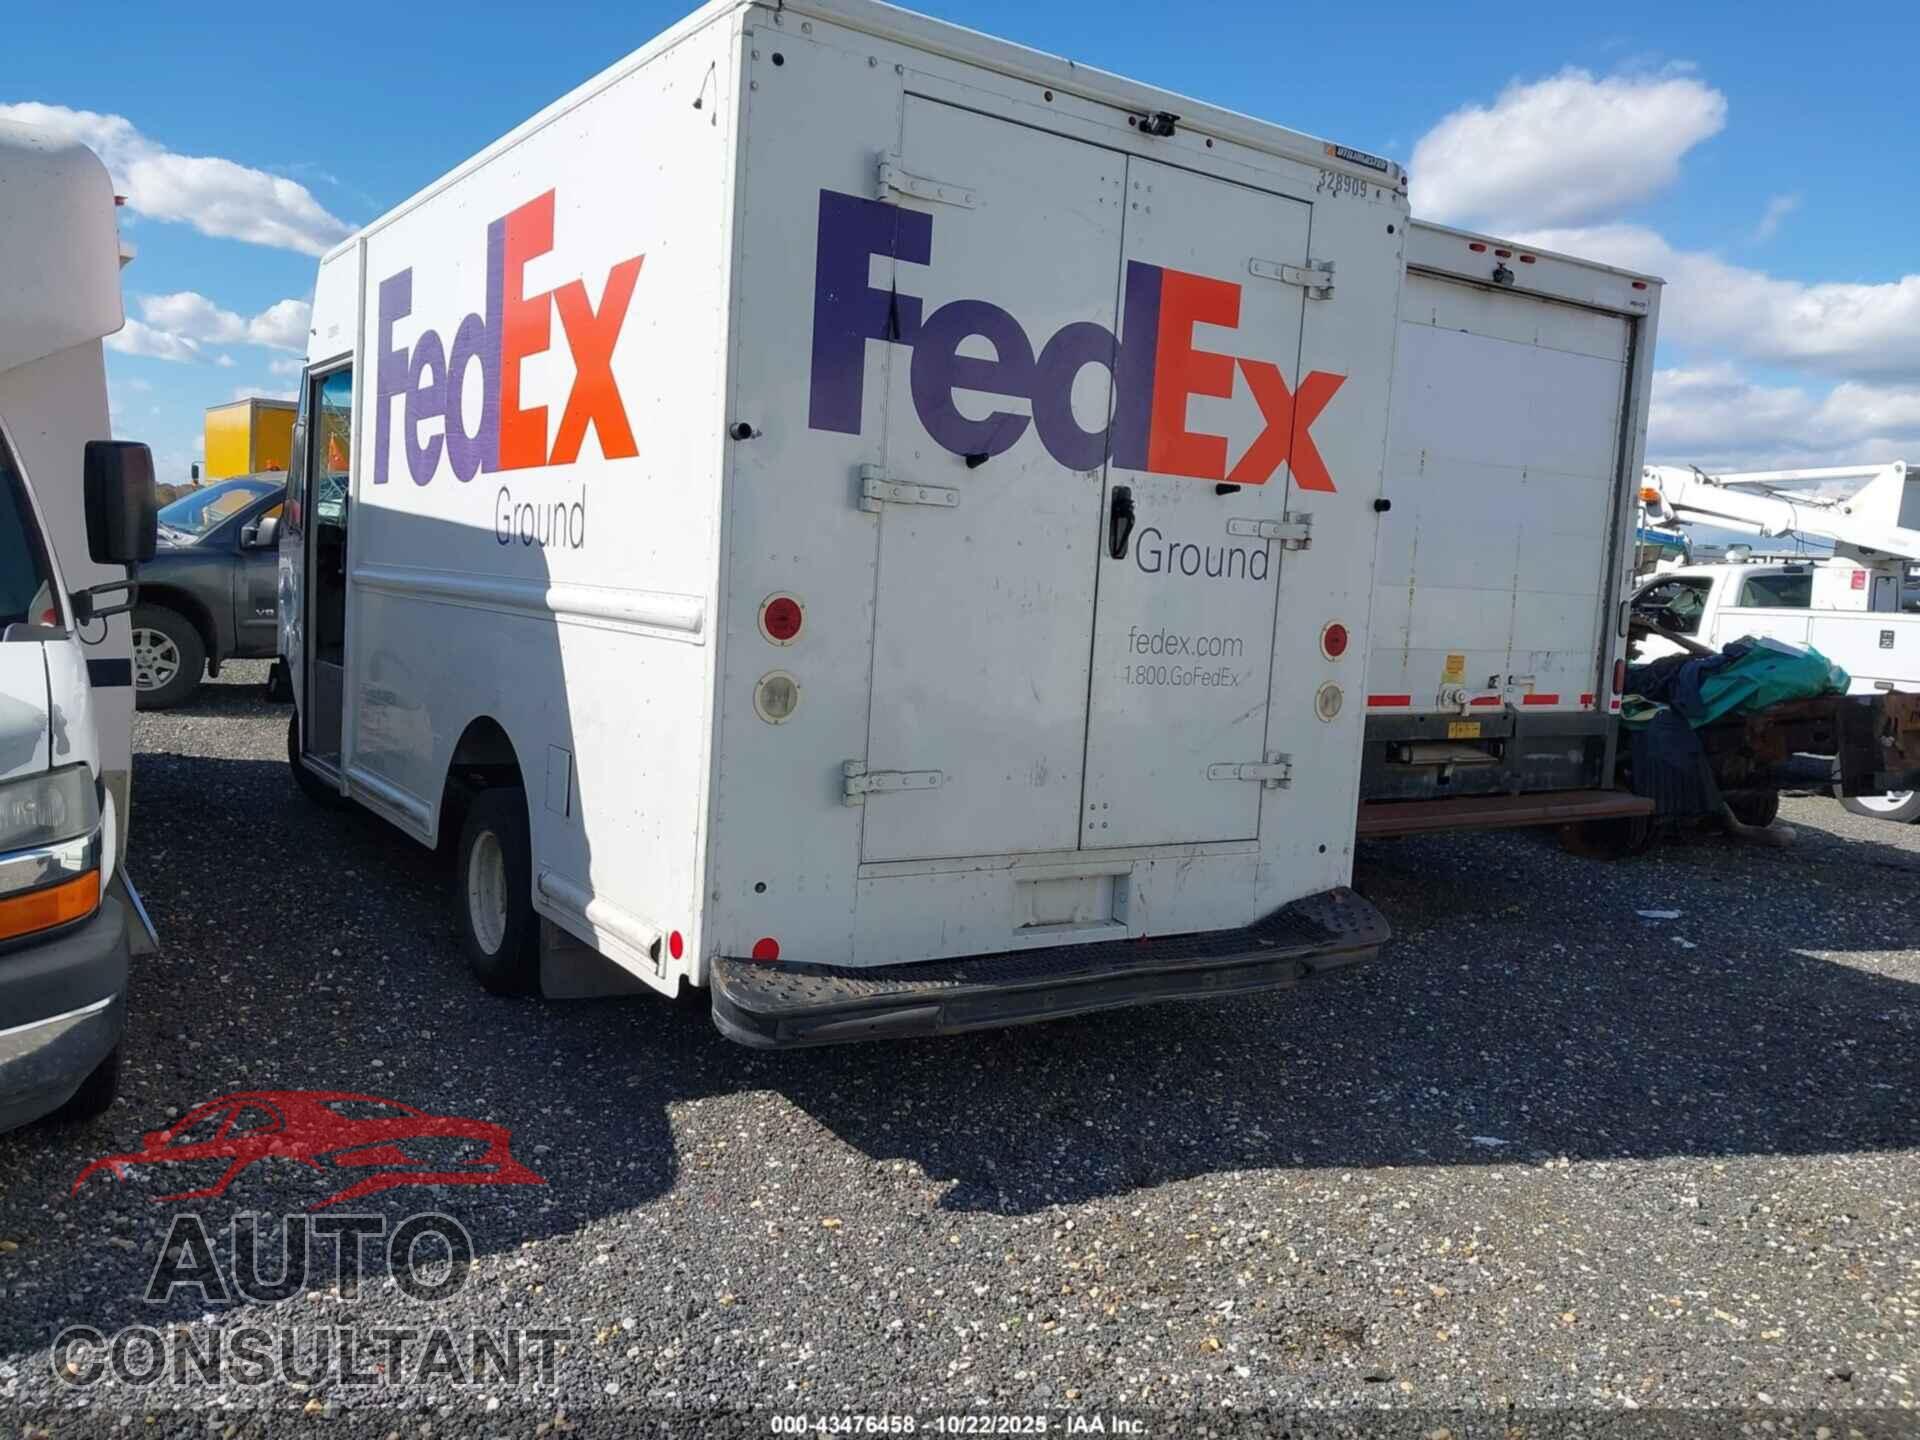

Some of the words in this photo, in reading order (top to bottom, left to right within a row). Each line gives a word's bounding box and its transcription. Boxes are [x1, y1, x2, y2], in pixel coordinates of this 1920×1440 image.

[1319, 168, 1368, 198] 328909
[374, 187, 645, 487] FedEx
[808, 188, 1348, 493] FedEx
[495, 484, 586, 549] Ground
[1136, 527, 1270, 581] Ground
[1128, 625, 1243, 657] fedex.com
[1125, 664, 1240, 687] 1.800.GoFedEx
